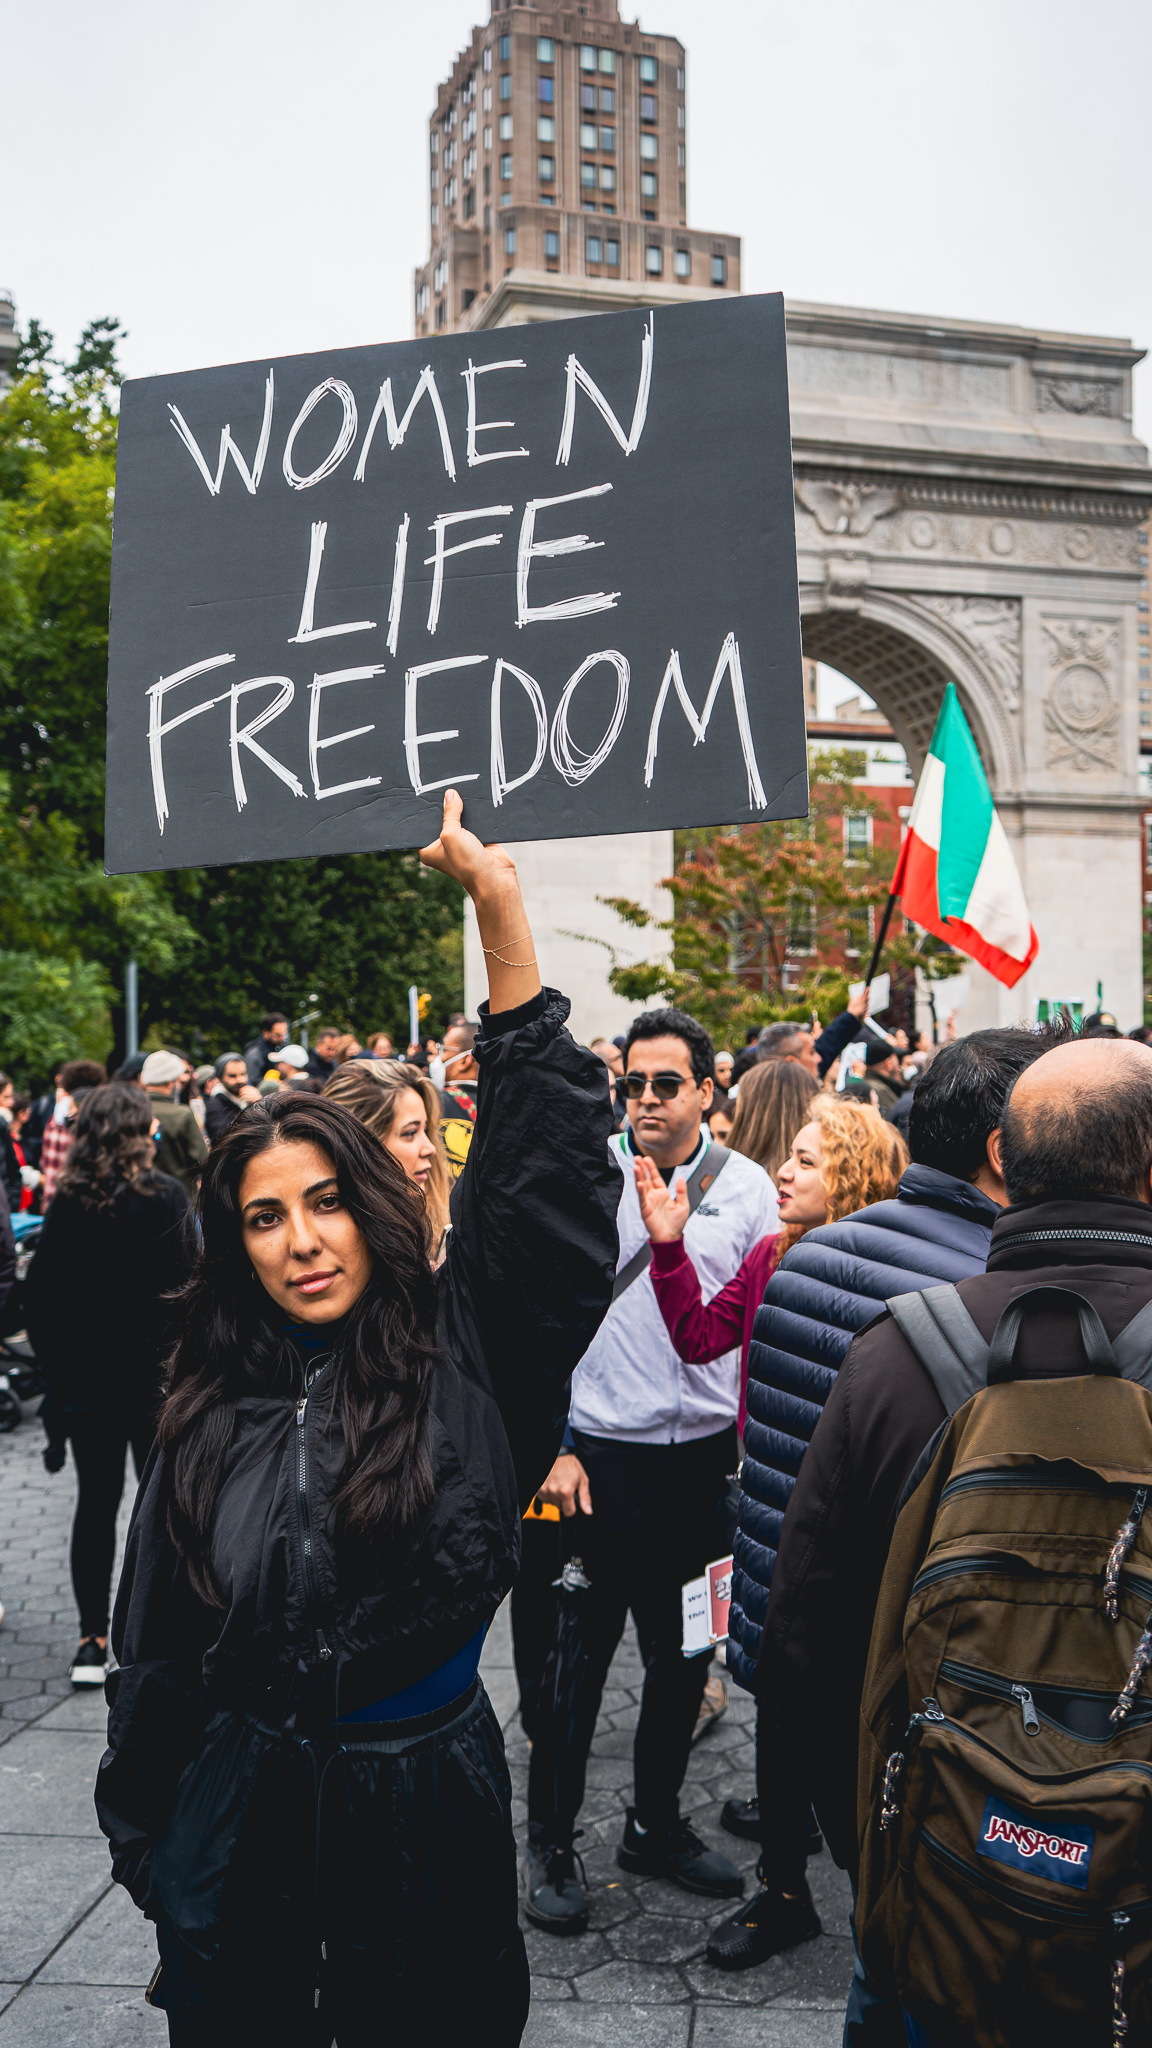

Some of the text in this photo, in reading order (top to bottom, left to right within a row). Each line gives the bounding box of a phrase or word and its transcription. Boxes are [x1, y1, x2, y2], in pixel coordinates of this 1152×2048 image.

[167, 311, 654, 497] WOMEN
[288, 483, 621, 657] LIFE
[145, 632, 767, 836] FREEDOM
[984, 1815, 1088, 1865] JANSPORT
